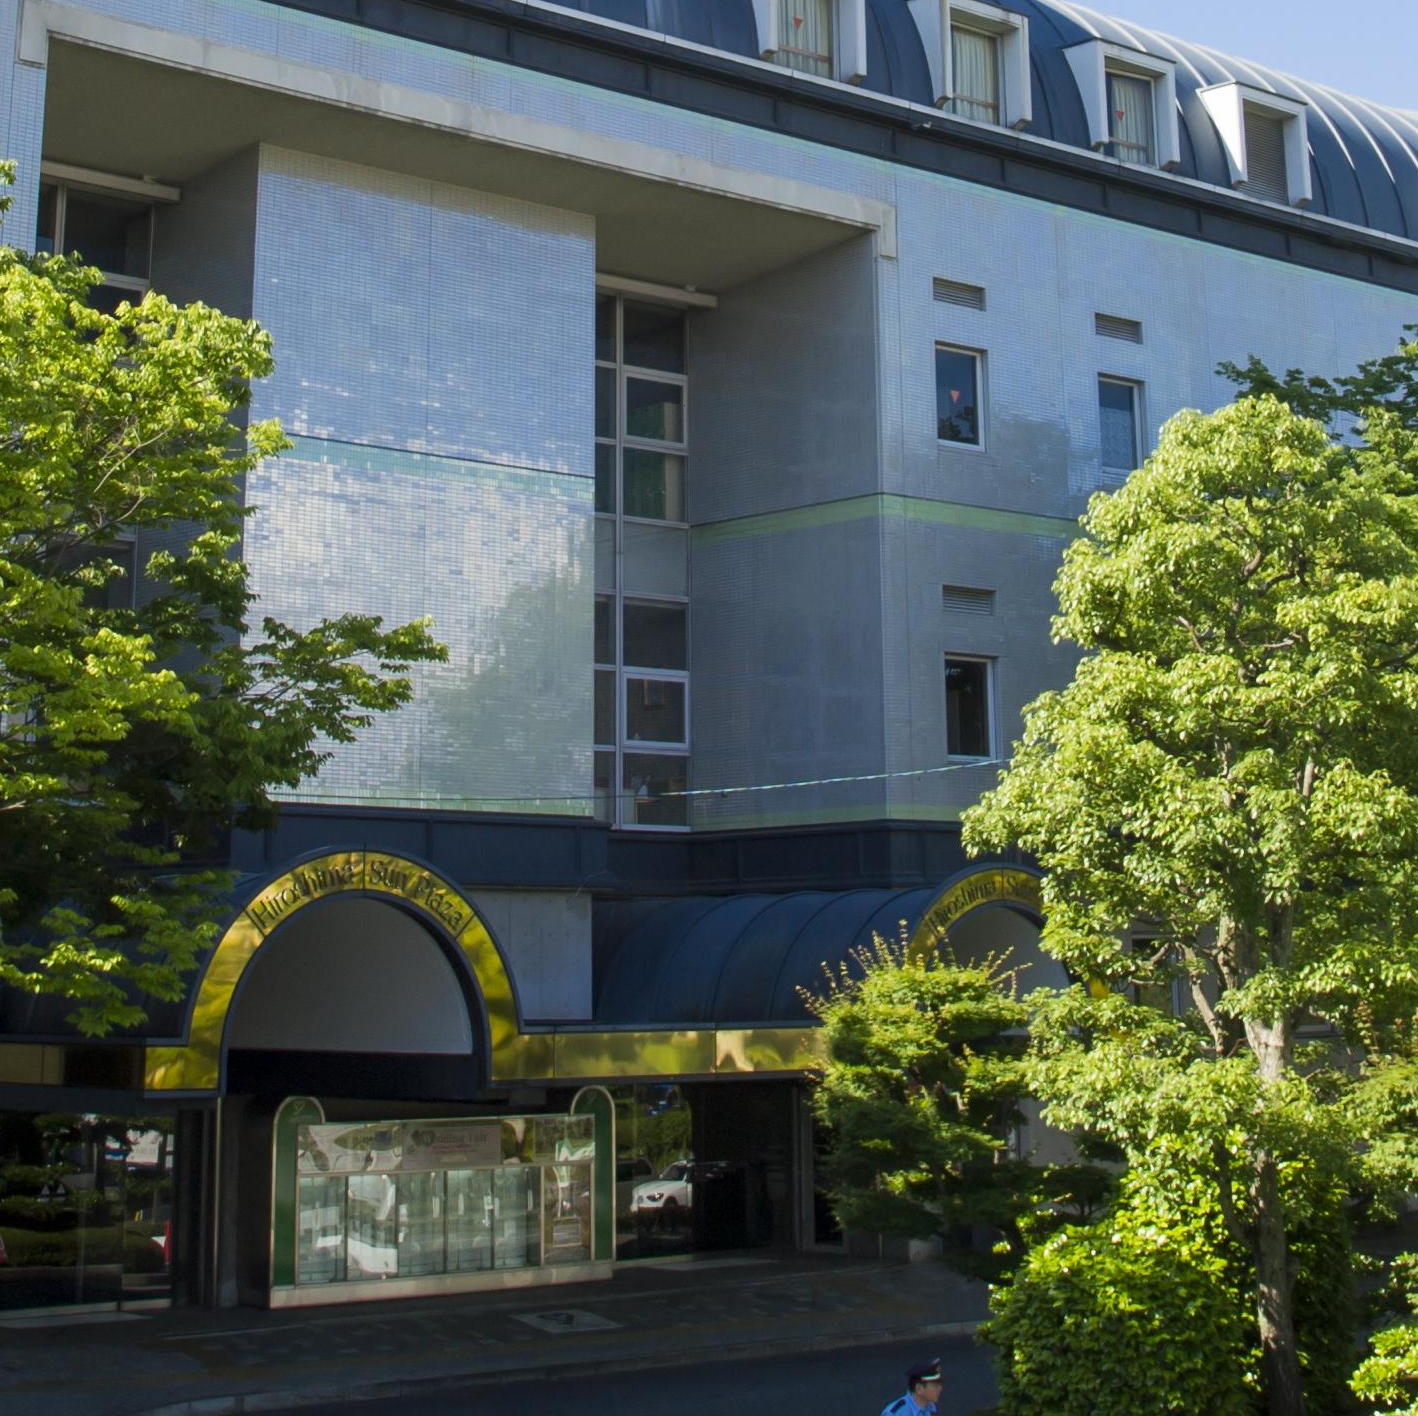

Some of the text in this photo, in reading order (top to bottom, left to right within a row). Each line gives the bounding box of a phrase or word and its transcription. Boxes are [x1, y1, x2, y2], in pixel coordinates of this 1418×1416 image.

[251, 859, 465, 930] Hiroshima Sun Plaza
